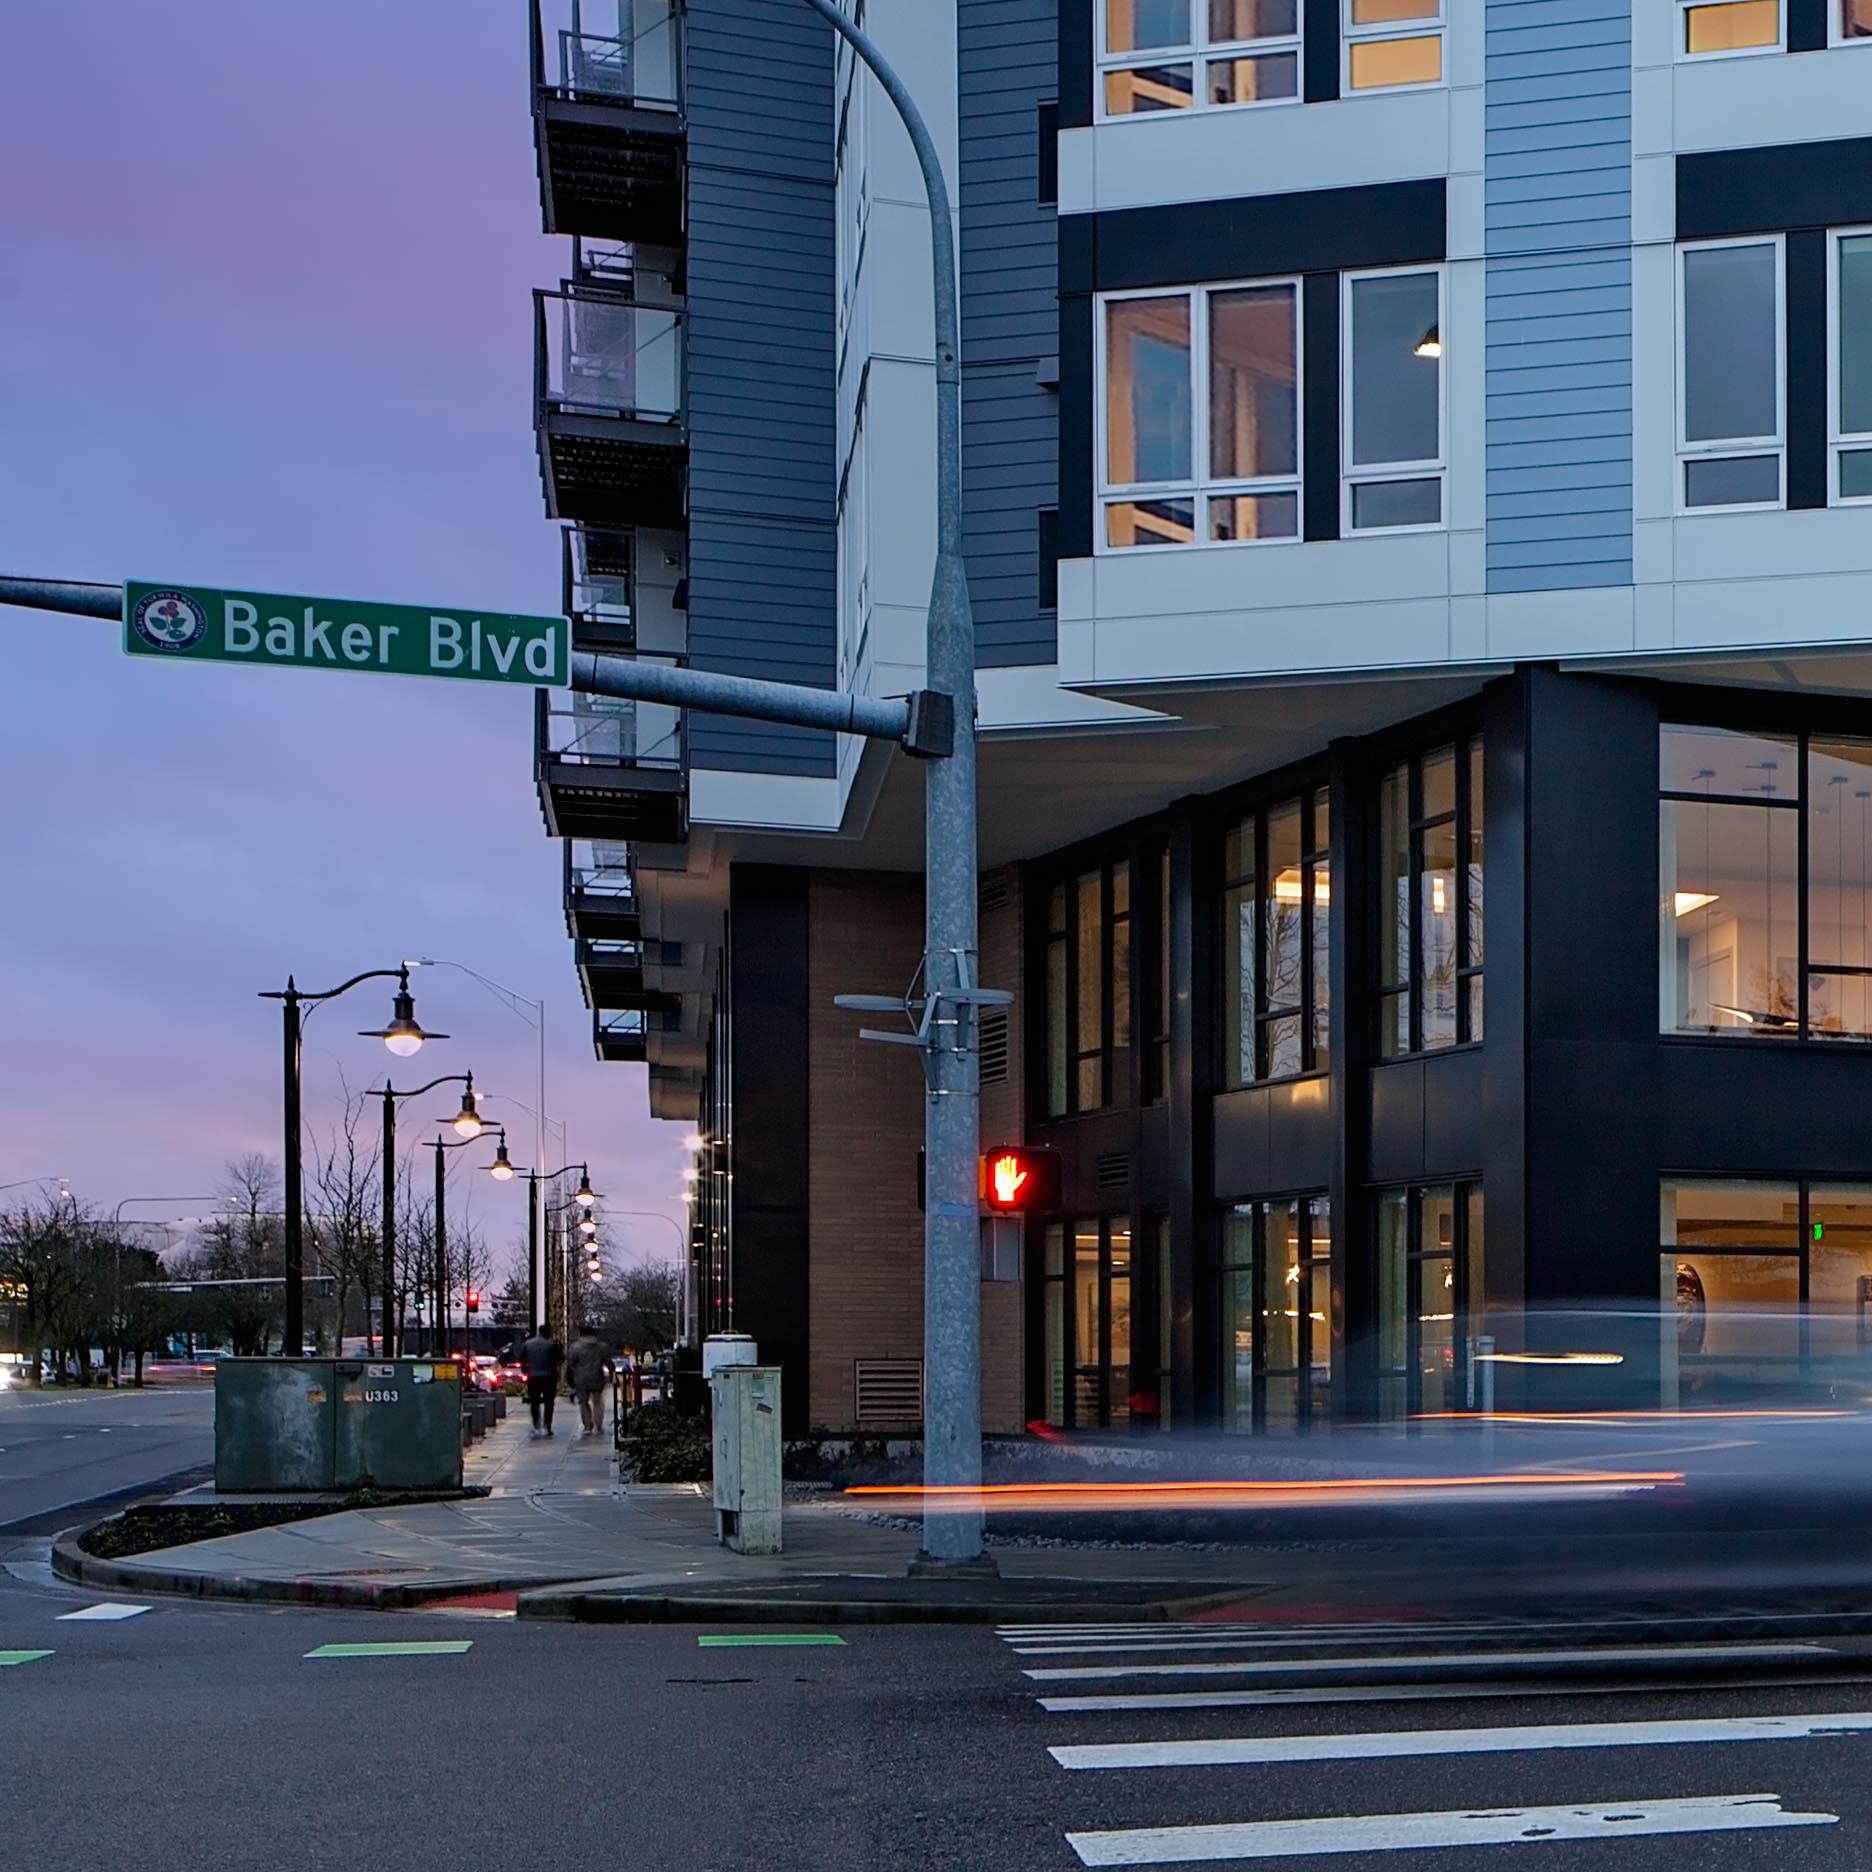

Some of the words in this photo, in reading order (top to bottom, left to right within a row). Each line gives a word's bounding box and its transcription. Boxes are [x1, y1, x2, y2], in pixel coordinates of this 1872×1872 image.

[224, 599, 399, 665] Baker
[429, 616, 556, 678] Blvd
[365, 1390, 399, 1402] U363
